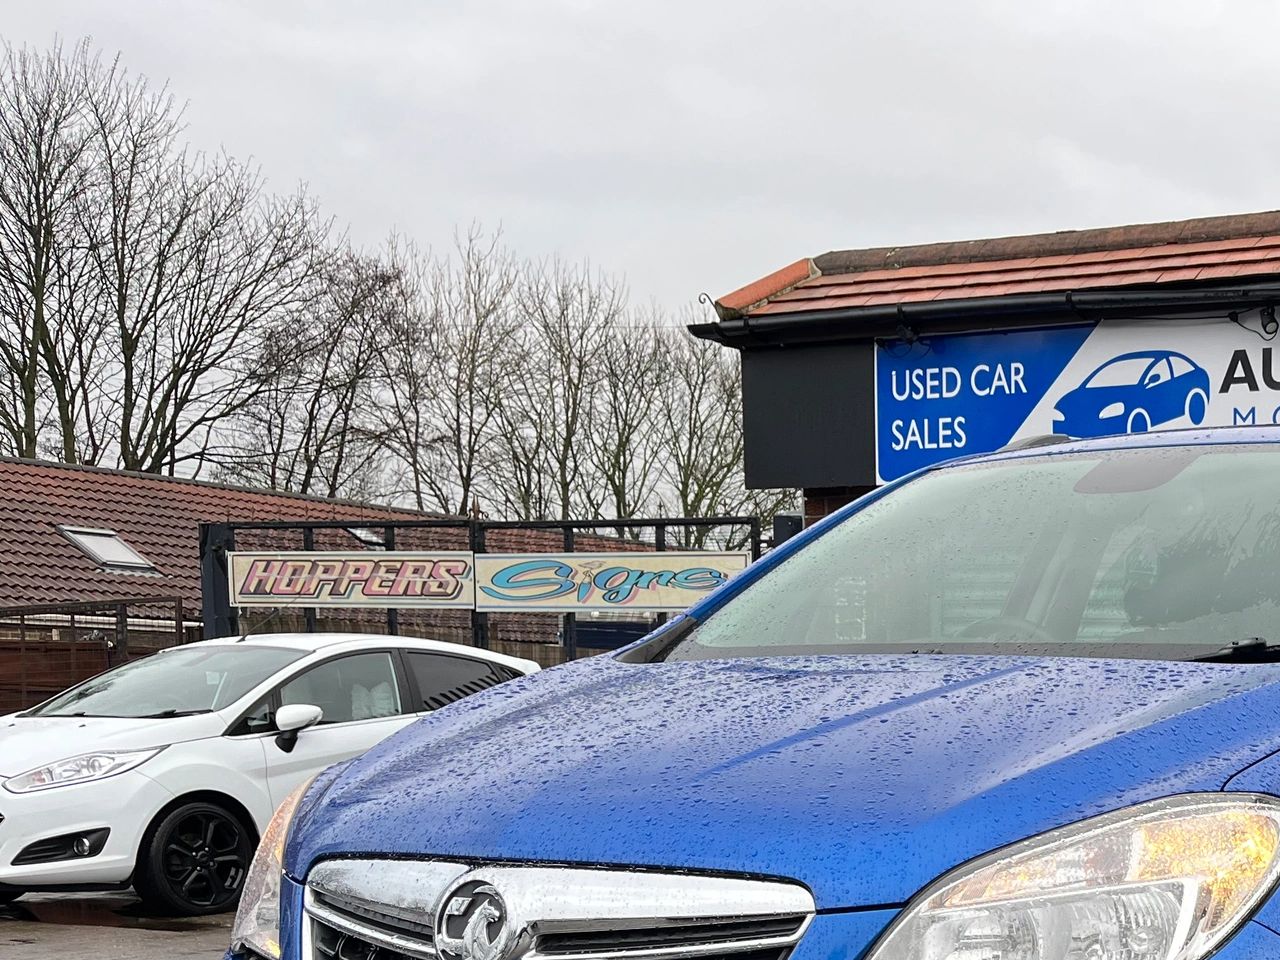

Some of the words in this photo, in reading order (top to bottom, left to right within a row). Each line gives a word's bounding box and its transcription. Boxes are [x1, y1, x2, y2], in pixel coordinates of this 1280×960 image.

[891, 368, 960, 402] USED
[970, 362, 1027, 396] CAR
[891, 416, 966, 452] SALES
[237, 559, 471, 601] HOPPERS
[479, 559, 729, 603] Signs
